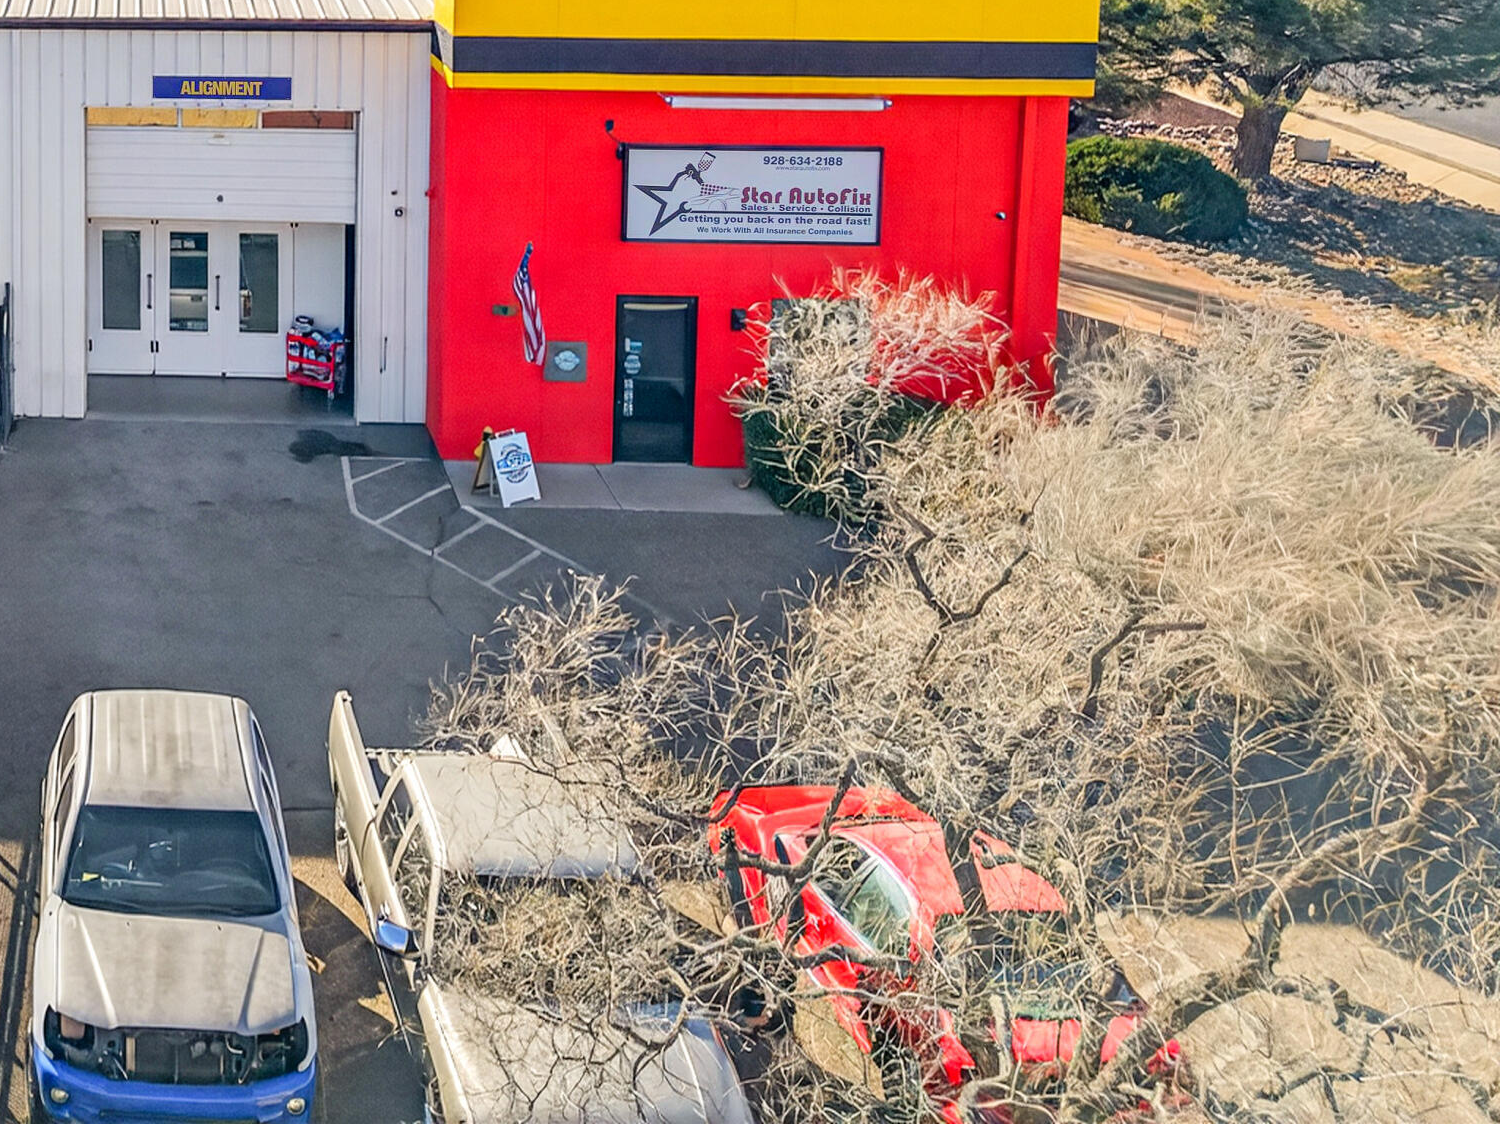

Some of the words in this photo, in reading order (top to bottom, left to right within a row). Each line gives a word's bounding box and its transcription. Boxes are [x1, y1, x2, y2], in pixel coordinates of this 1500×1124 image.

[180, 80, 263, 96] ALIGNMENT
[763, 156, 843, 166] 928-634-2188
[741, 186, 782, 204] Star
[740, 204, 768, 212] Sales
[779, 204, 817, 212] Service
[827, 205, 871, 213] Collision
[678, 214, 720, 225] Getting
[724, 216, 743, 225] you
[747, 214, 775, 224] back
[778, 217, 792, 225] on
[795, 215, 814, 225] the
[816, 215, 842, 226] road
[845, 216, 871, 226] fast!
[696, 226, 709, 234] We
[711, 226, 732, 234] Work
[733, 227, 752, 235] With
[753, 227, 764, 235] All
[808, 228, 853, 237] Companies
